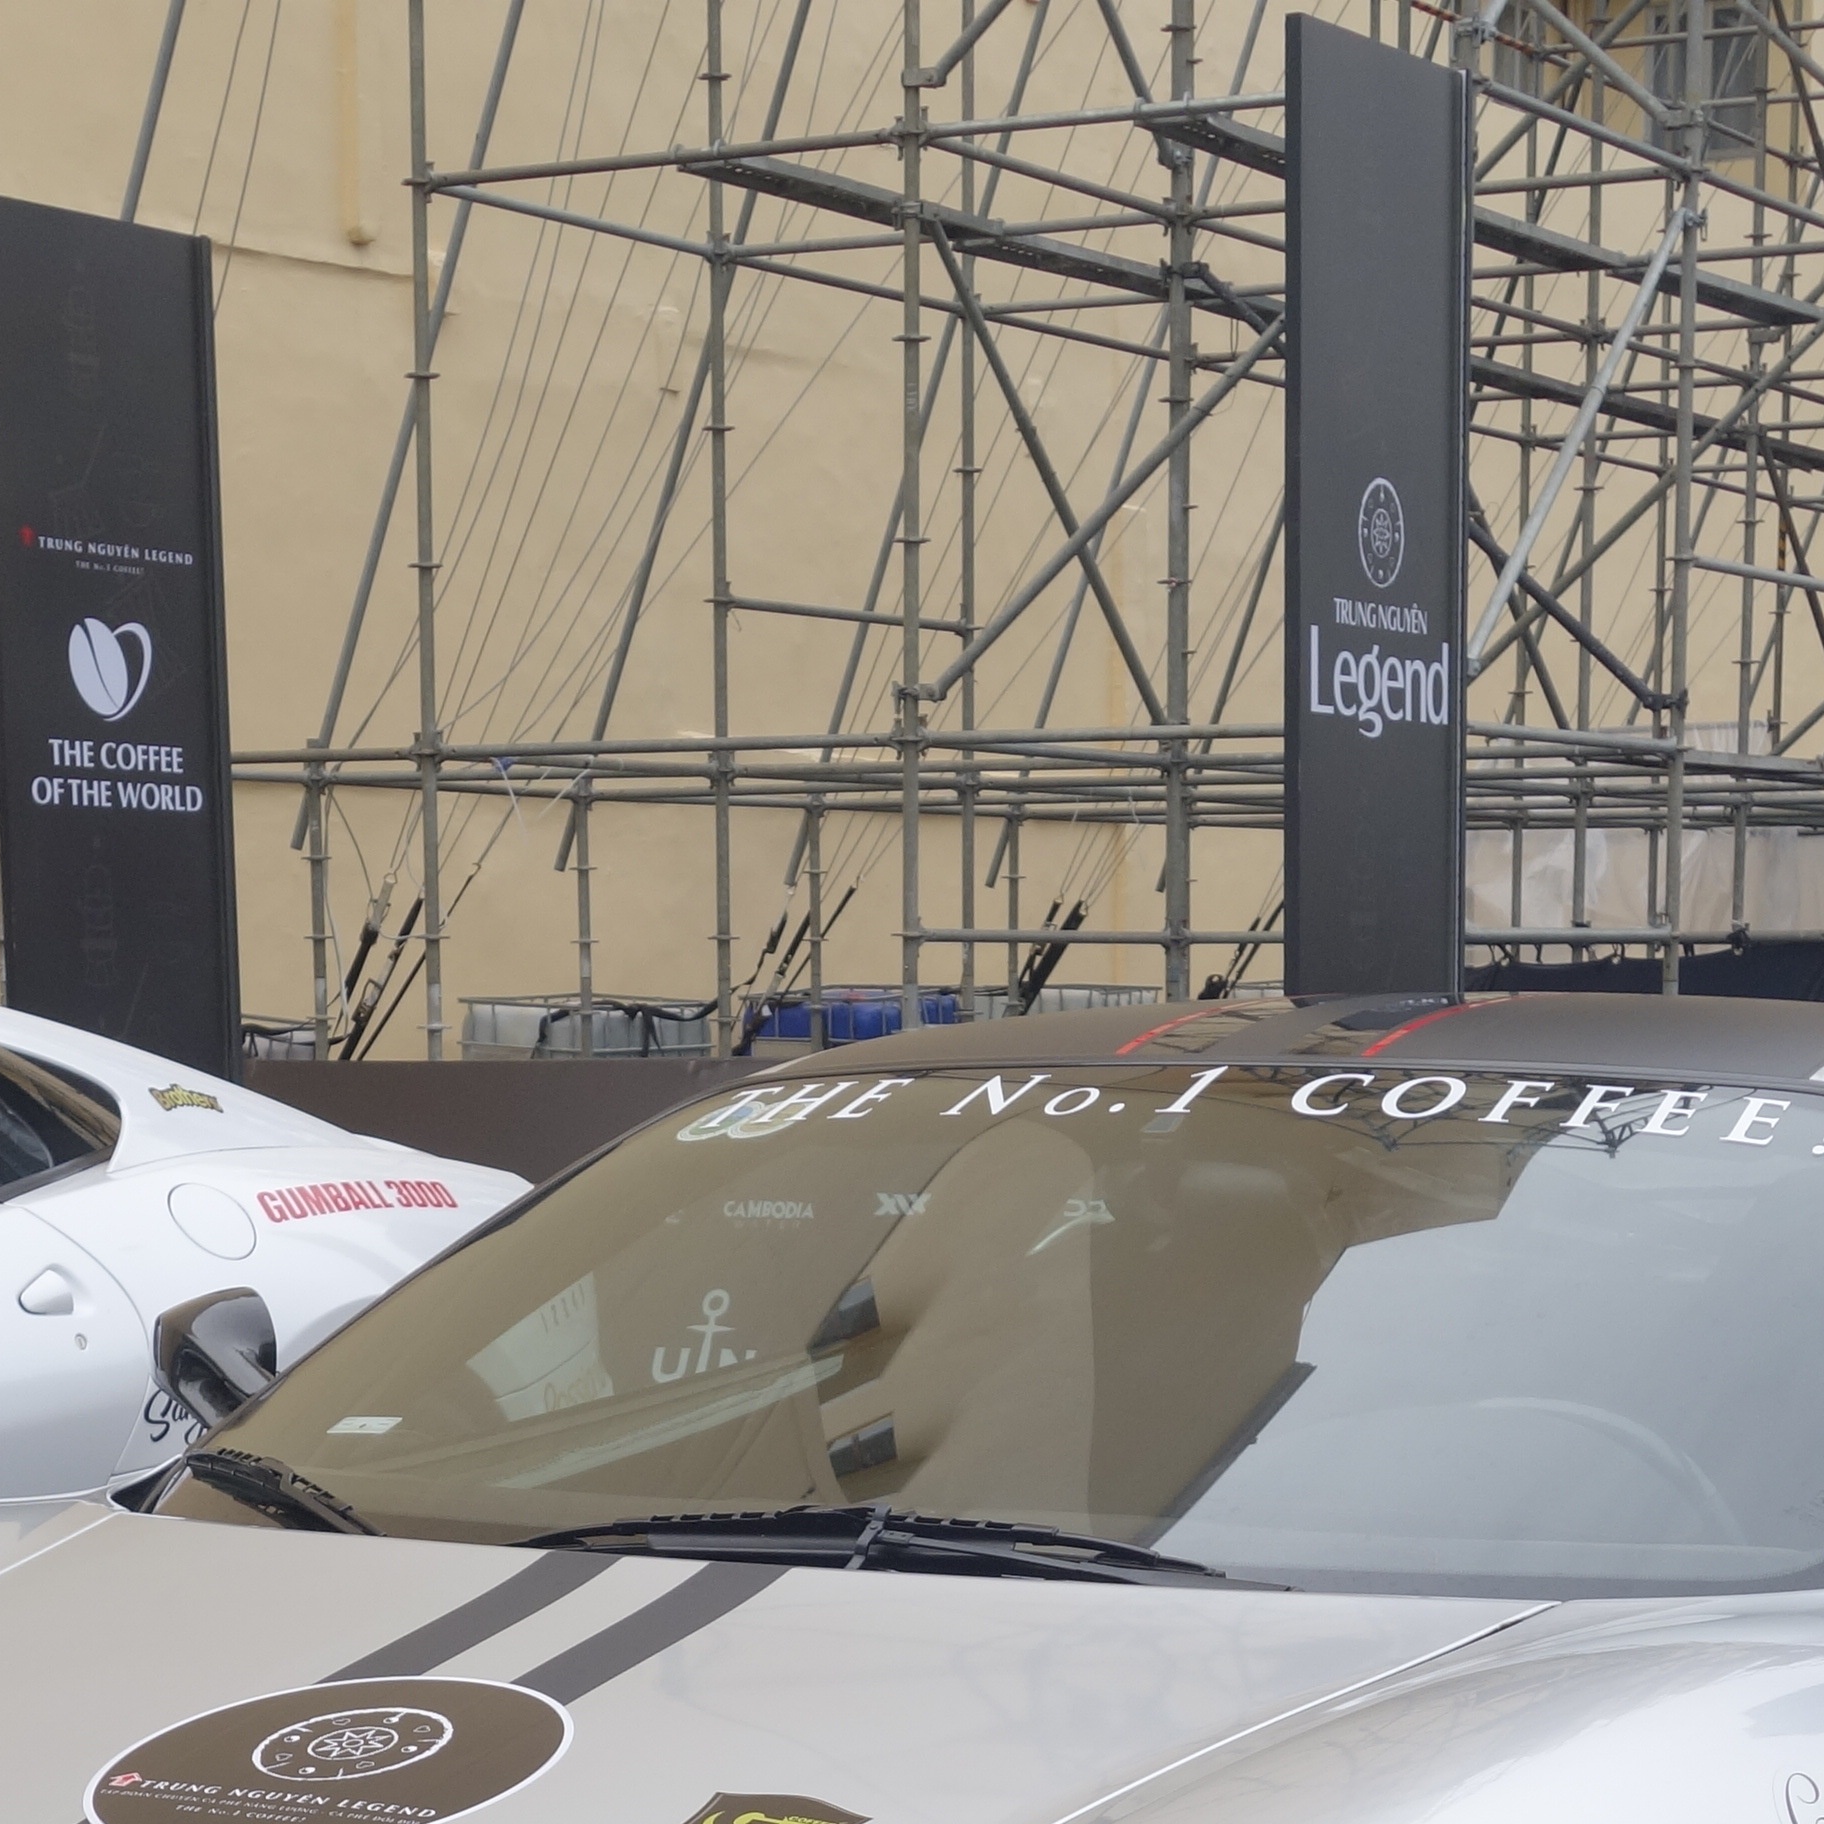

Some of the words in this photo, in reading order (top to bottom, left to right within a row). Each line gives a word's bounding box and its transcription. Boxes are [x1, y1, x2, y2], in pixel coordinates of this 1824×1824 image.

[38, 534, 84, 554] TRUNG
[87, 541, 140, 560] NGUYÊN
[144, 548, 194, 566] LEGEND
[1333, 597, 1377, 628] TRUNG
[1377, 603, 1428, 635] NGUYÊN
[1309, 624, 1450, 739] Legend
[48, 738, 95, 768] THE
[99, 741, 185, 774] COFFEE
[31, 776, 66, 804] OF
[67, 778, 112, 808] THE
[116, 780, 204, 812] WORLD
[701, 1077, 916, 1130] THE
[256, 1181, 394, 1223] GUMBALL
[384, 1179, 459, 1209] 3000
[723, 1199, 815, 1220] CAMBODIA
[140, 1780, 223, 1795] TRUNG
[228, 1787, 331, 1806] NGUYÊN
[336, 1799, 437, 1818] LEGEND
